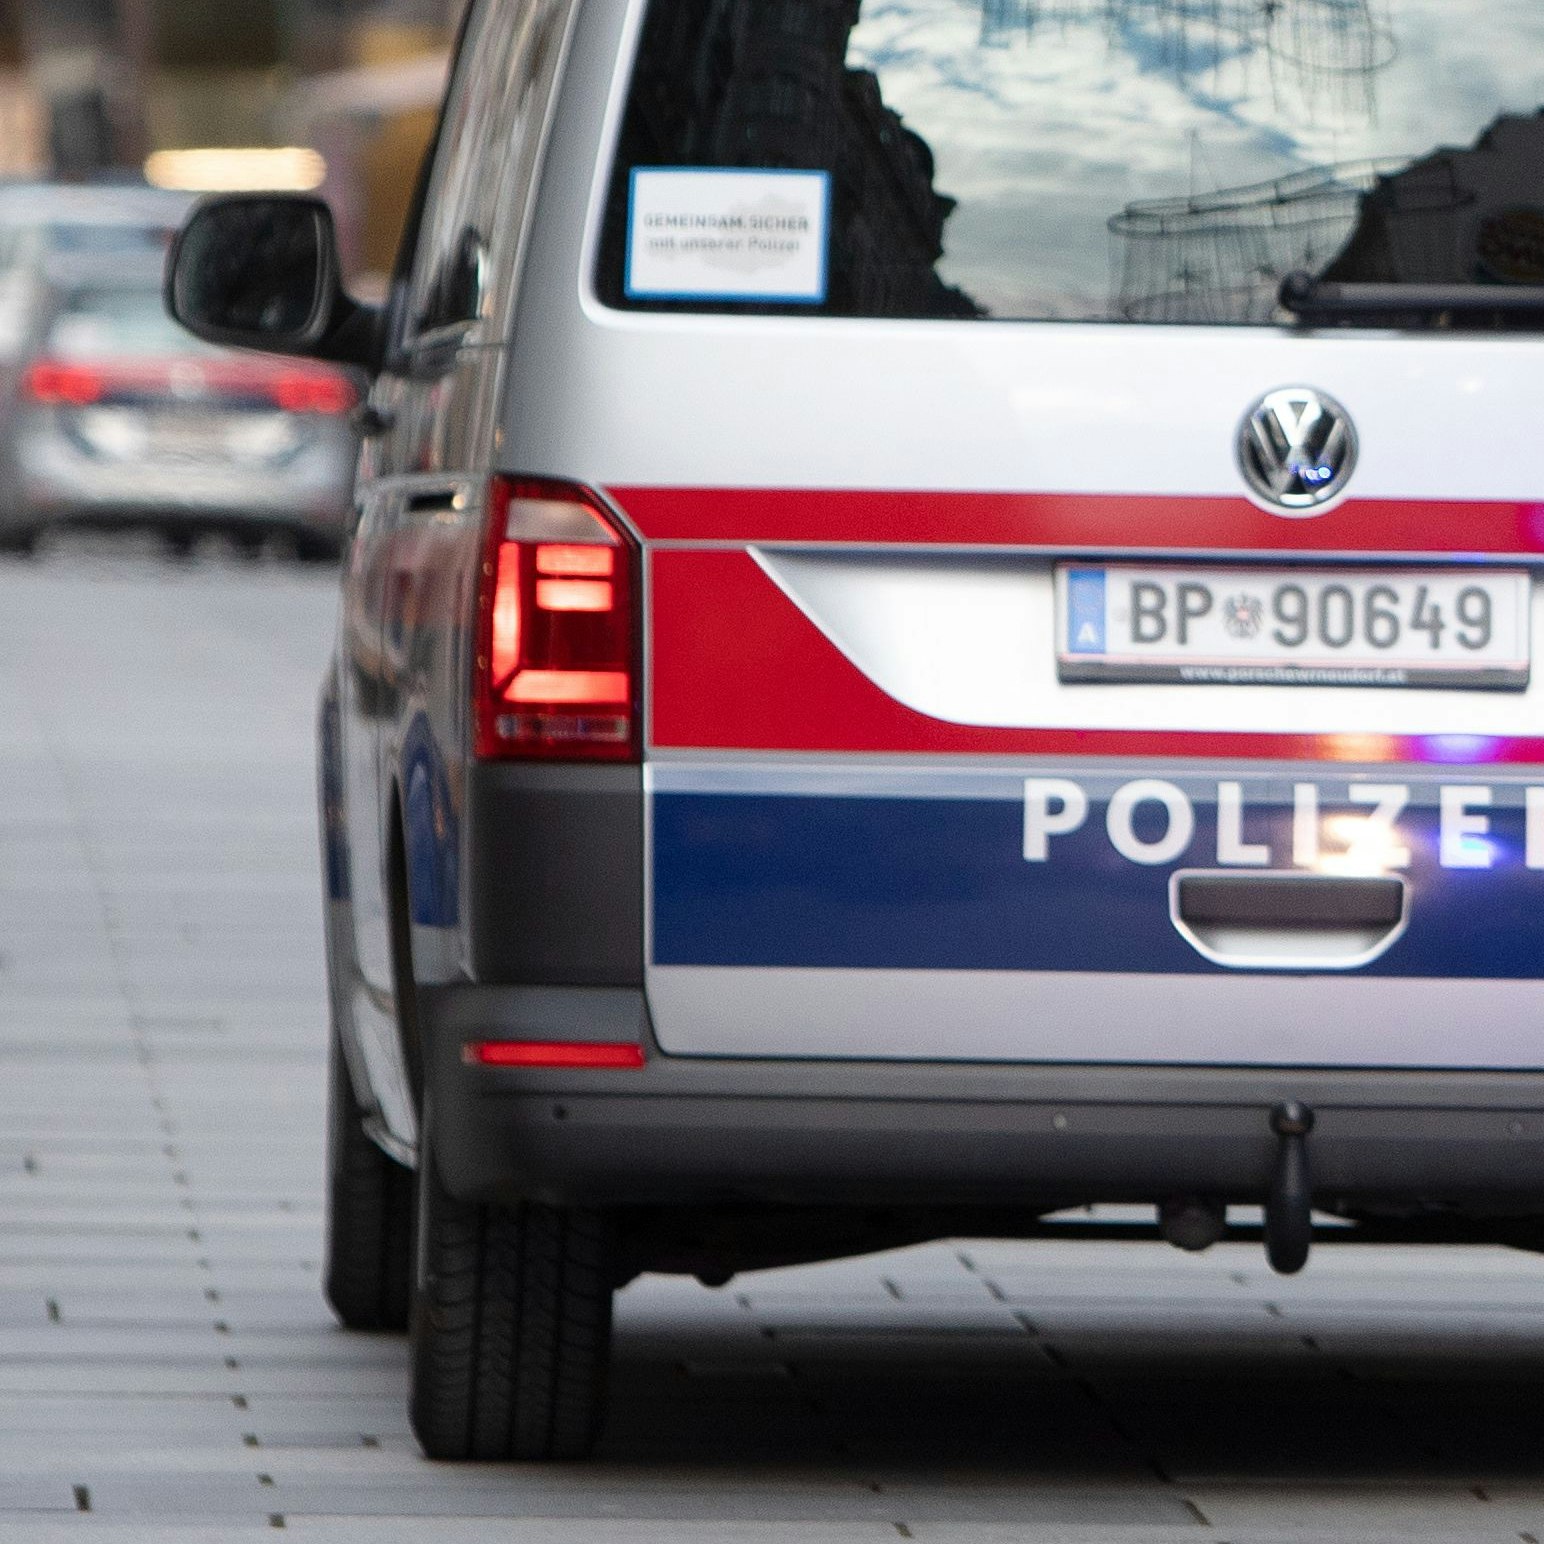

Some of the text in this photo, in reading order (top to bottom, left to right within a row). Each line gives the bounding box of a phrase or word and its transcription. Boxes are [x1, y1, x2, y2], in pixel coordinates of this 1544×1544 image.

[681, 236, 742, 251] unserer
[749, 234, 801, 251] Polizei
[1130, 579, 1493, 650] BP 90649
[1077, 622, 1096, 643] A
